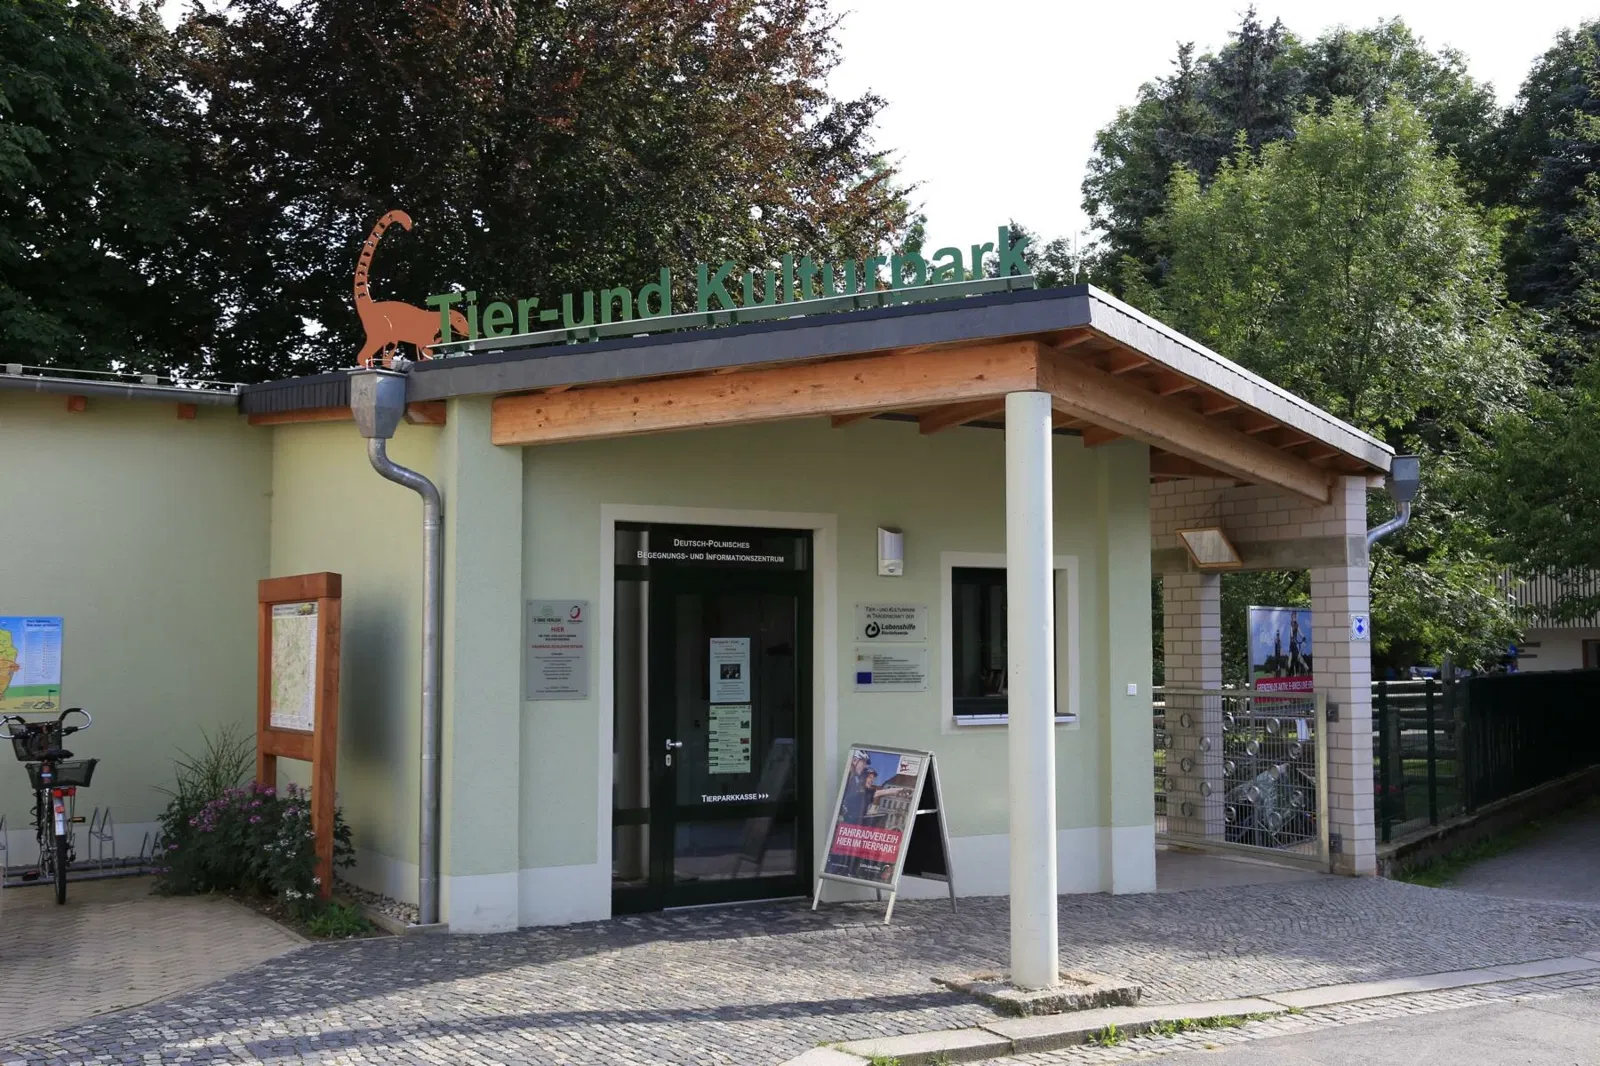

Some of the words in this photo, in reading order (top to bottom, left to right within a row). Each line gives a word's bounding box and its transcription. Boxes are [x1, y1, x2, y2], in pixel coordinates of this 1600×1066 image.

[697, 226, 1031, 313] Kulturpark
[637, 550, 689, 560] BEGEGNUNGS-
[705, 552, 785, 563] INFORMATIONSZENTRUM
[701, 793, 757, 803] TIERPARKKASSE
[838, 826, 899, 844] FAHRRADVERLEIH
[836, 836, 852, 847] HIER
[852, 838, 861, 848] IM
